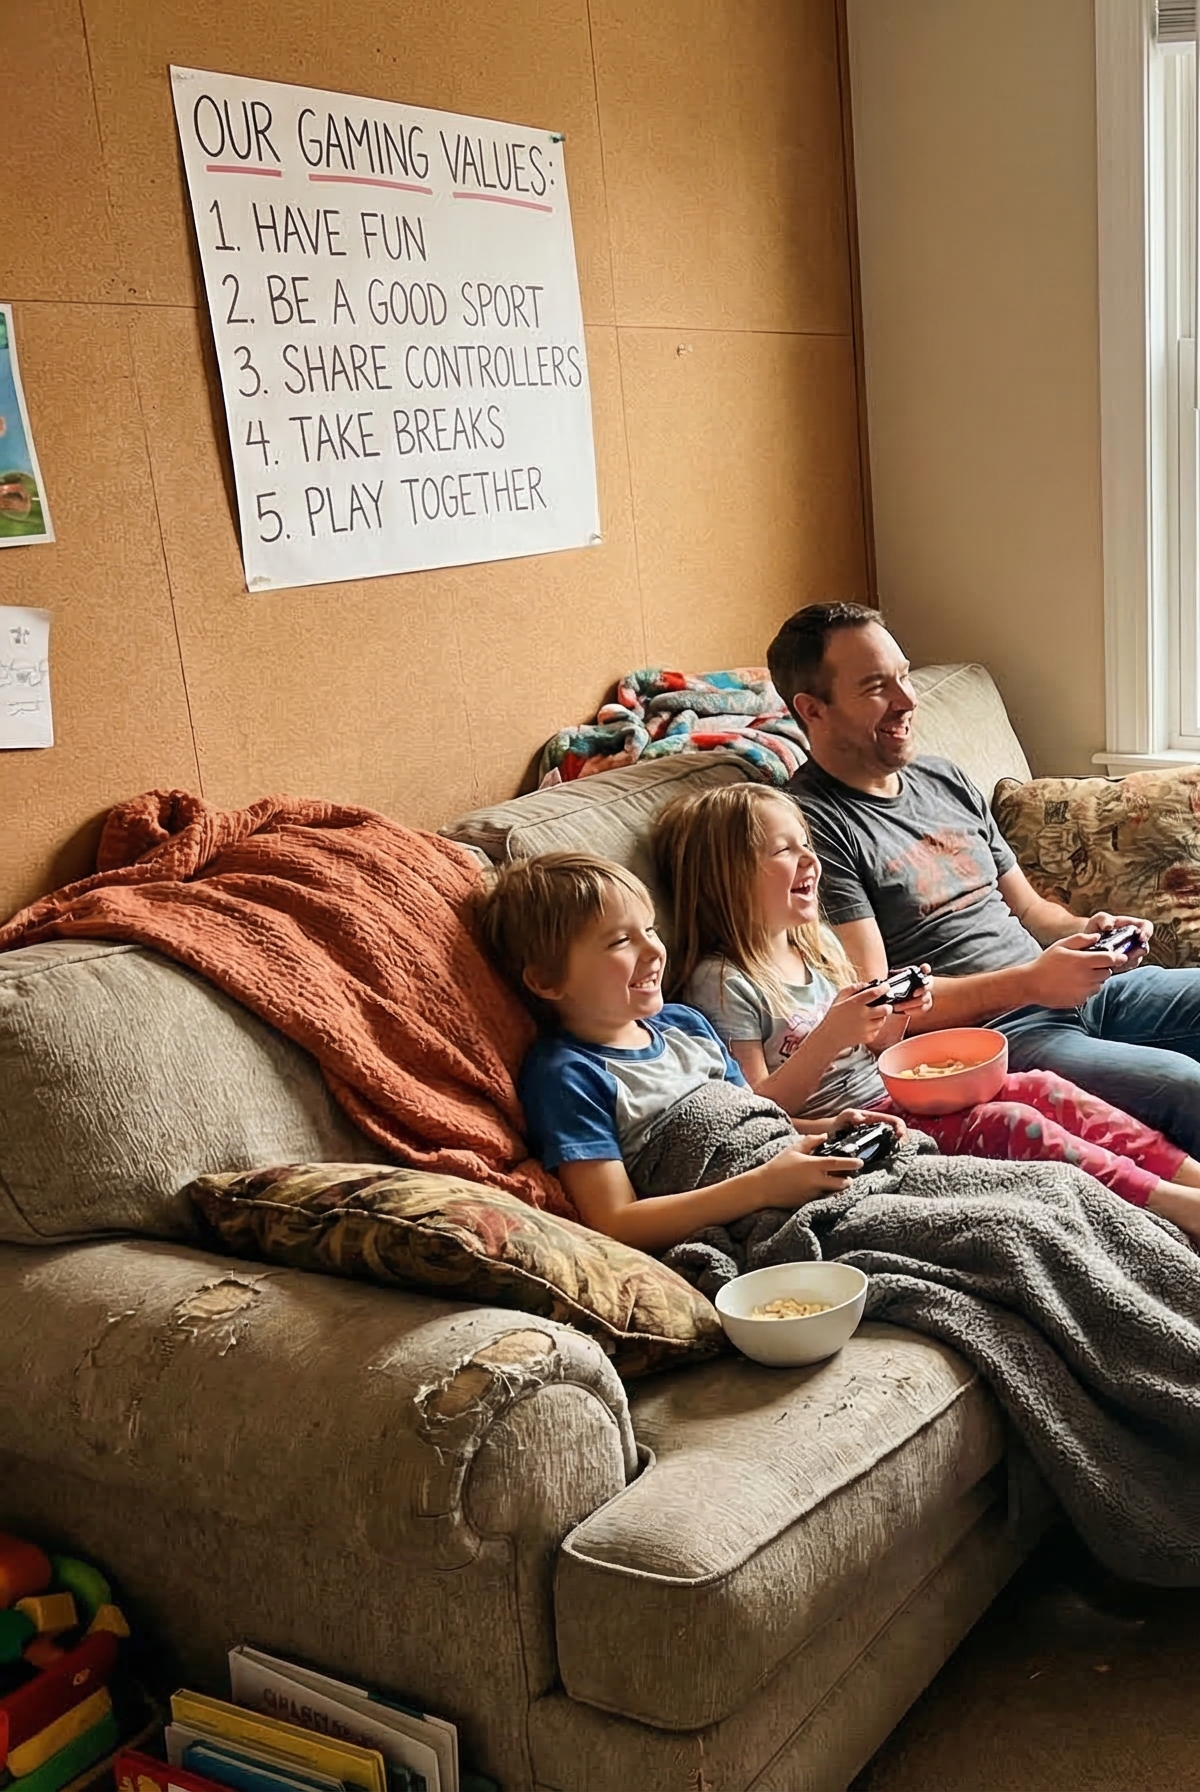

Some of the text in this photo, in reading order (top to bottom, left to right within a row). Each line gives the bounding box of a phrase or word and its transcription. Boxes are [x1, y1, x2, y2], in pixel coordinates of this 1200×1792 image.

[193, 94, 558, 199] OUR GAMING VALUES:
[209, 199, 427, 262] 1. HAVE FUN
[221, 273, 544, 329] 2. BE A GOOD SPORT
[233, 343, 582, 398] 3. SHARE CONTROLLERS
[245, 404, 505, 467] 4. TAKE BREAKS
[256, 466, 547, 543] 5. PLAY TOGETHER
